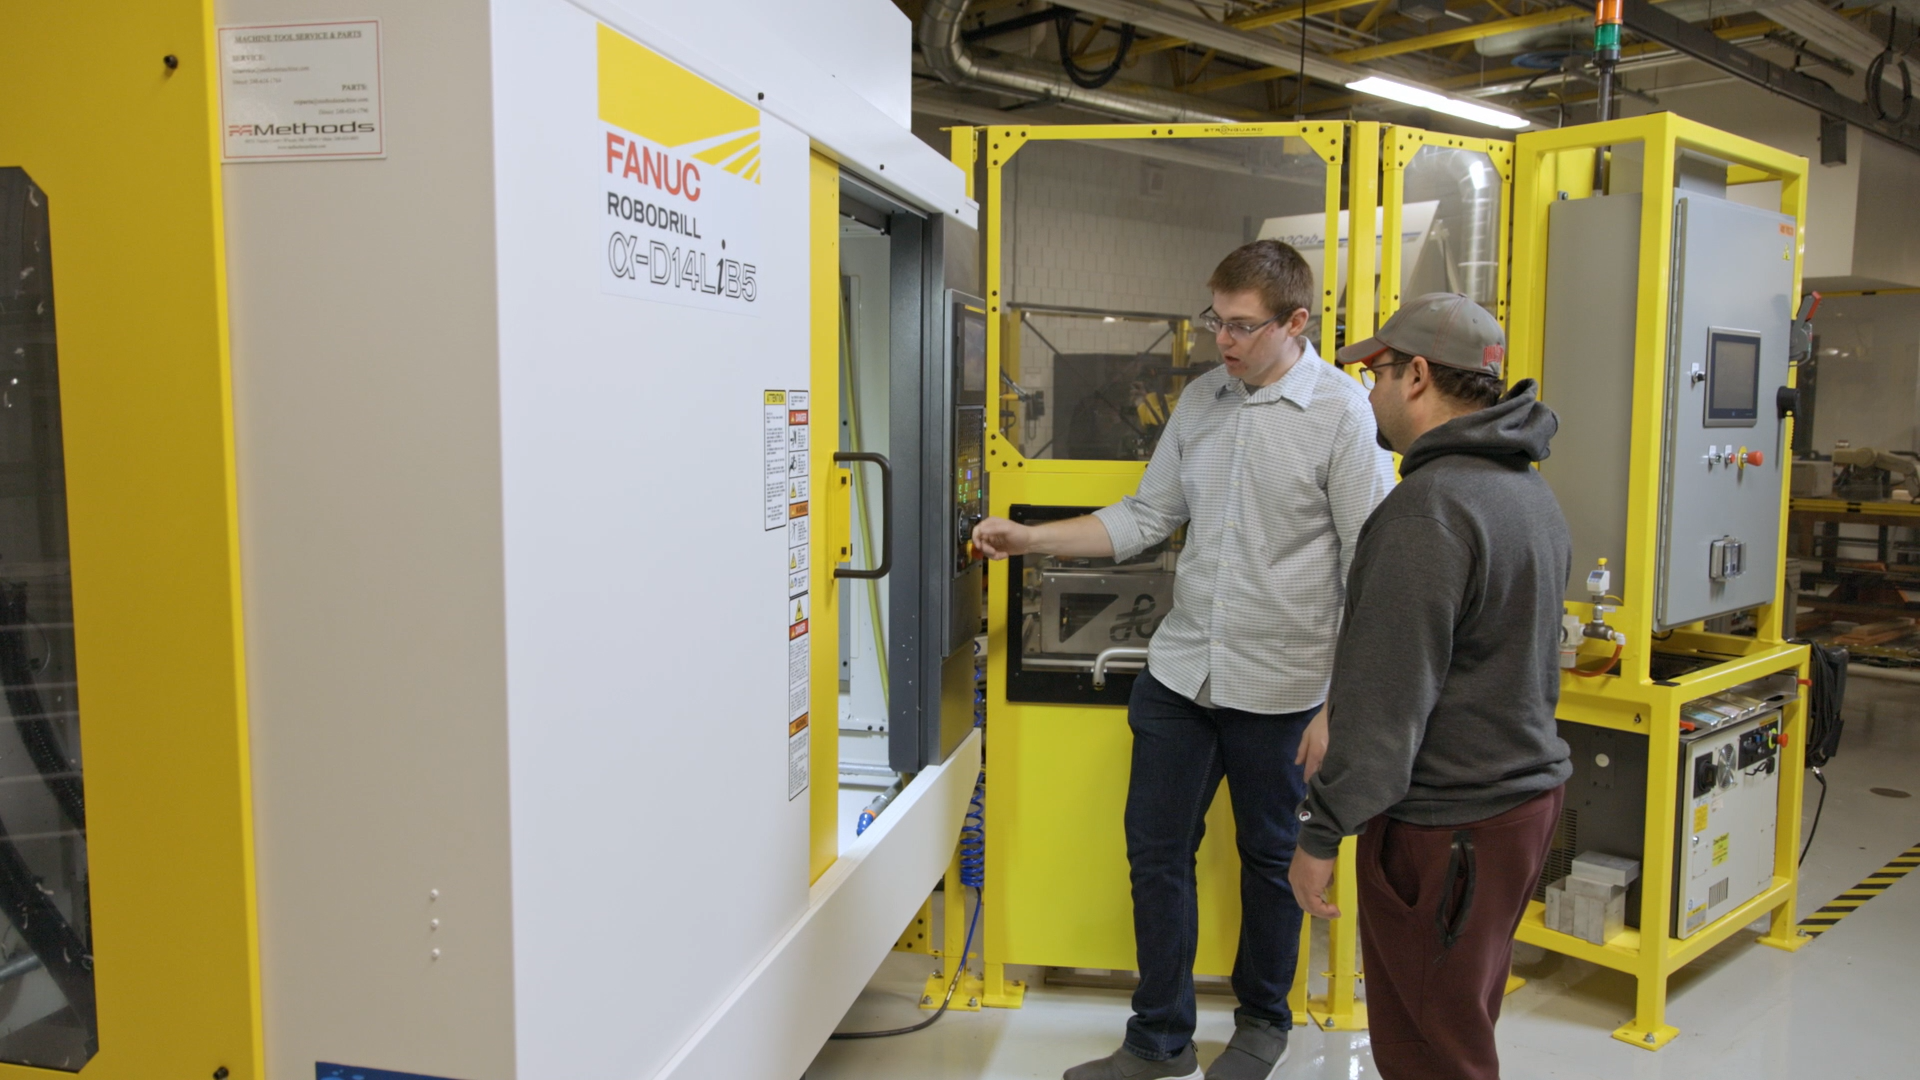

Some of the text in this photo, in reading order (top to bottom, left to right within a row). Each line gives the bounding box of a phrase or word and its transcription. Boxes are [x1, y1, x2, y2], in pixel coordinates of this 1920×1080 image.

[273, 33, 293, 42] TOOL
[295, 32, 328, 41] SERVICE
[329, 31, 336, 39] &
[337, 30, 362, 40] PARTS
[254, 121, 375, 136] Methods
[606, 131, 702, 202] FANUC
[607, 191, 702, 239] ROBODRILL
